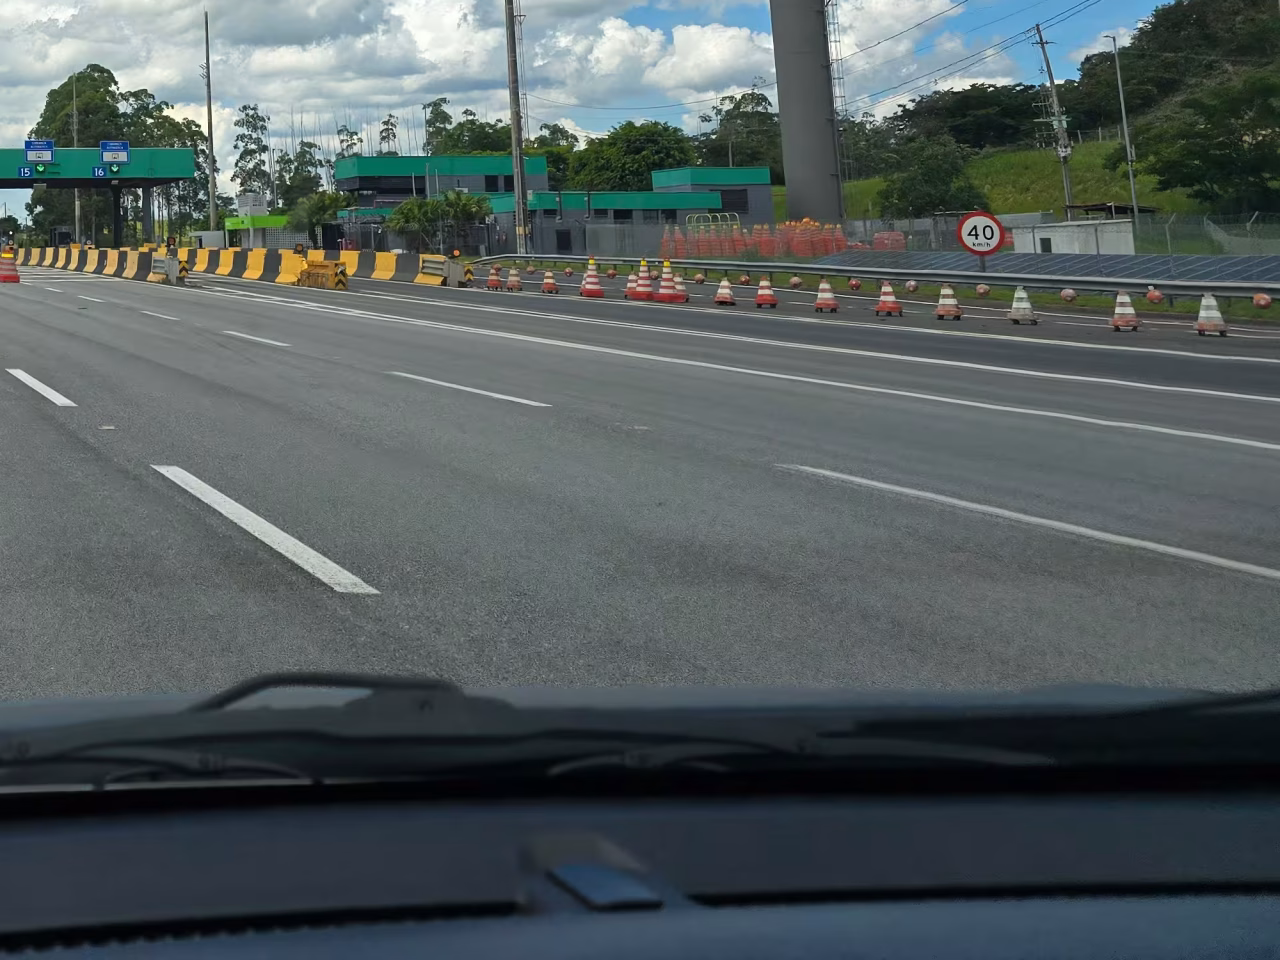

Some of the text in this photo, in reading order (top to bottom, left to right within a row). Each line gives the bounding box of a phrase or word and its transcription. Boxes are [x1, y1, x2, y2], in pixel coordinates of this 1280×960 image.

[20, 168, 30, 177] 15
[94, 168, 104, 177] 16
[967, 224, 995, 241] 40
